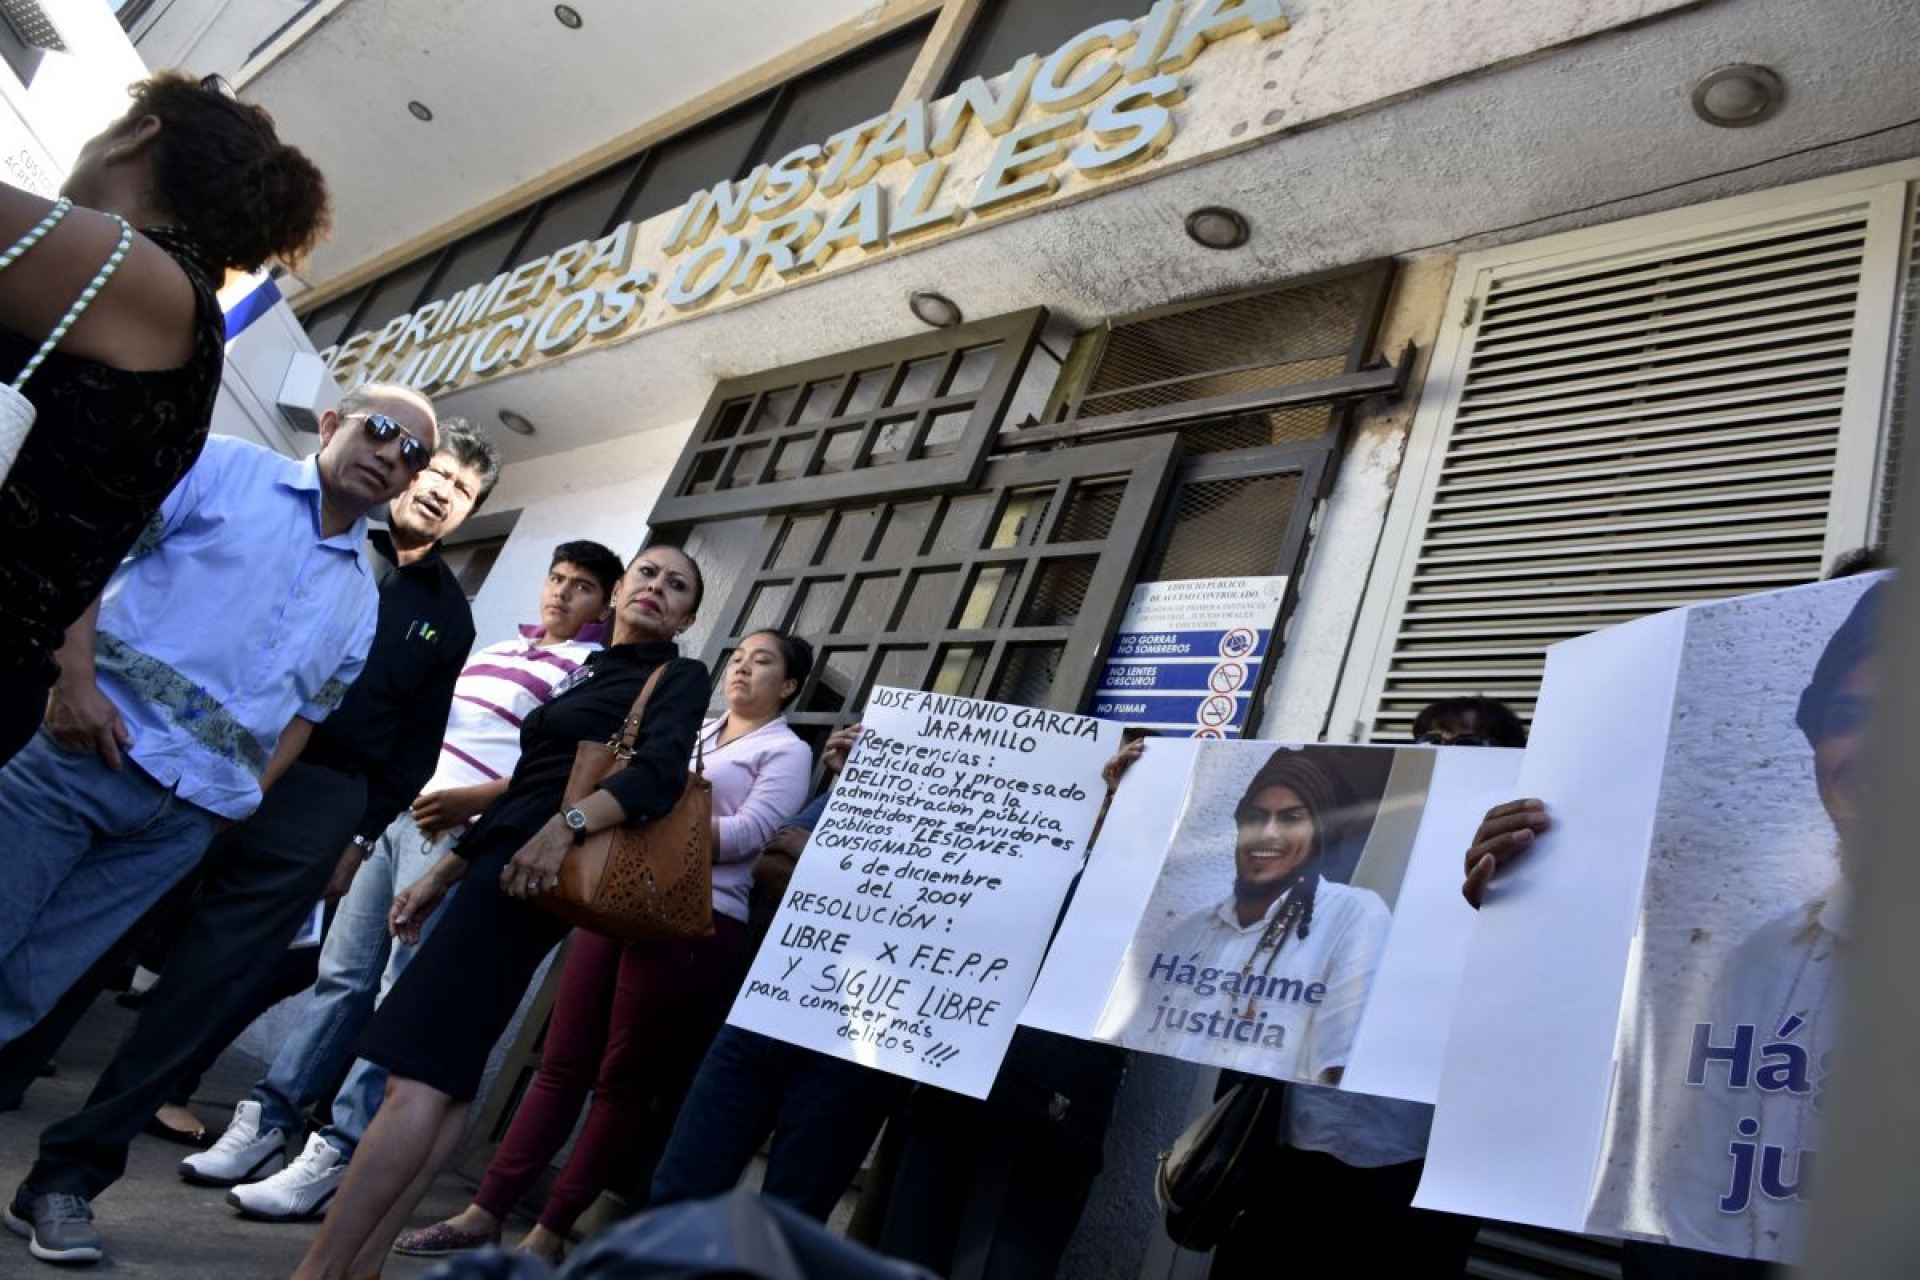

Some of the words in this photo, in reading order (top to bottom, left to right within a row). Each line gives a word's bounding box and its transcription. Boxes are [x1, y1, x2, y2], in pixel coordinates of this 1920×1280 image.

[364, 220, 634, 366] PRIMERA
[663, 0, 1288, 255] INSTANCIA
[400, 268, 656, 392] JUICIOS
[664, 73, 1186, 312] ORALES
[1117, 645, 1133, 654] NO
[1134, 644, 1191, 654] SOMBREROS
[1121, 636, 1137, 644] NO
[1138, 635, 1177, 644] GORRAS
[1106, 676, 1157, 686] OBSCUROS
[1109, 667, 1125, 676] NO
[1126, 666, 1158, 676] LENTES
[918, 694, 1008, 723] ANTONIO
[1012, 709, 1099, 742] GARCÍA
[1097, 704, 1113, 713] NO
[1114, 703, 1147, 713] FUMAR
[918, 716, 1037, 752] JARAMILLO
[848, 750, 945, 778] Indiciado
[969, 773, 1087, 801] procesado
[928, 783, 996, 804] contra
[1002, 792, 1022, 808] la
[815, 830, 932, 858] CONSIGNADO
[819, 815, 894, 836] públicos
[913, 828, 1023, 858] LESIONES.
[830, 801, 916, 824] cometidos
[911, 816, 947, 832] por
[953, 821, 1075, 851] servidores
[839, 853, 853, 871] 6
[861, 858, 890, 876] de
[894, 861, 1002, 890] diciembre
[787, 890, 936, 930] RESOLUCIÓN
[916, 887, 973, 908] 2004
[780, 923, 850, 954] LIBRE
[811, 964, 911, 1010] SIGUE
[1149, 951, 1327, 1005] Háganme
[745, 980, 791, 1001] para
[799, 994, 886, 1023] cometer
[890, 1019, 933, 1038] más
[1148, 995, 1287, 1049] justicia
[836, 1020, 914, 1053] delitos
